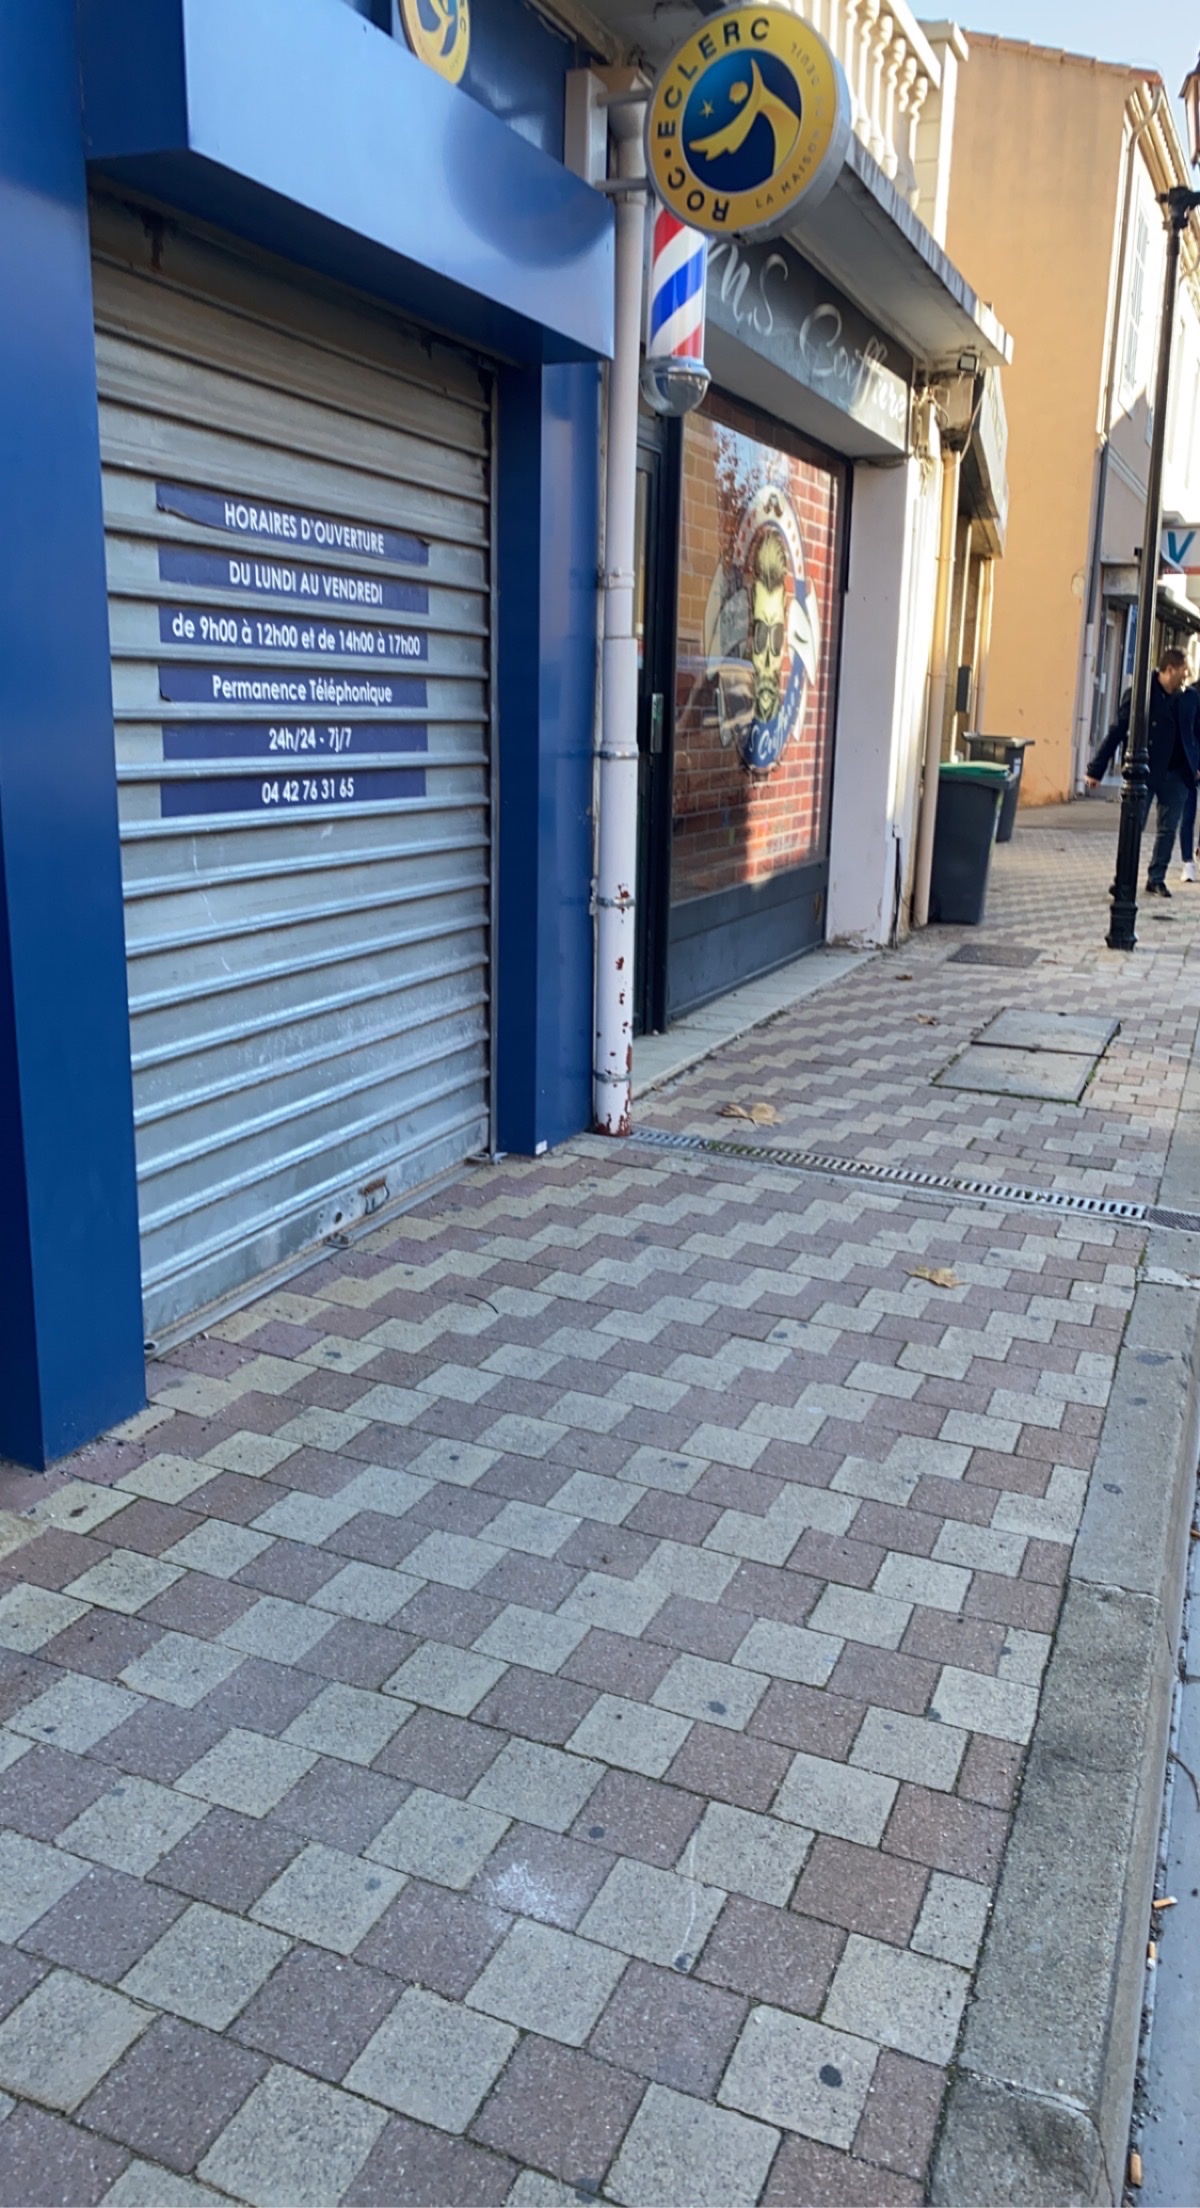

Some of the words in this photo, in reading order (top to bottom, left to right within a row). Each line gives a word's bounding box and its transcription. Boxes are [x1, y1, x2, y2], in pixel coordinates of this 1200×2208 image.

[657, 18, 770, 139] ECLERC
[667, 166, 731, 223] ROC
[755, 193, 774, 209] LA
[224, 502, 298, 539] HORAIRES
[301, 517, 385, 555] D'OUVERTURE
[229, 560, 251, 586] DU
[255, 564, 297, 592] LUNDI
[300, 572, 319, 596] AU
[323, 575, 383, 605] VENDREDI
[172, 612, 196, 639] de
[200, 615, 238, 644] 9h00
[241, 618, 253, 645] à
[256, 622, 299, 648] 12h00
[301, 627, 315, 649] et
[318, 628, 336, 651] de
[339, 630, 375, 653] 14h00
[377, 631, 386, 654] à
[388, 634, 421, 656] 17h00
[212, 674, 307, 701] Permanence
[309, 676, 393, 707] Téléphonique
[269, 727, 316, 752] 24h/24
[327, 726, 352, 753] 7j/7
[261, 781, 279, 804] 04
[282, 780, 300, 802] 42
[302, 779, 318, 801] 76
[321, 778, 335, 799] 31
[339, 776, 354, 798] 65
